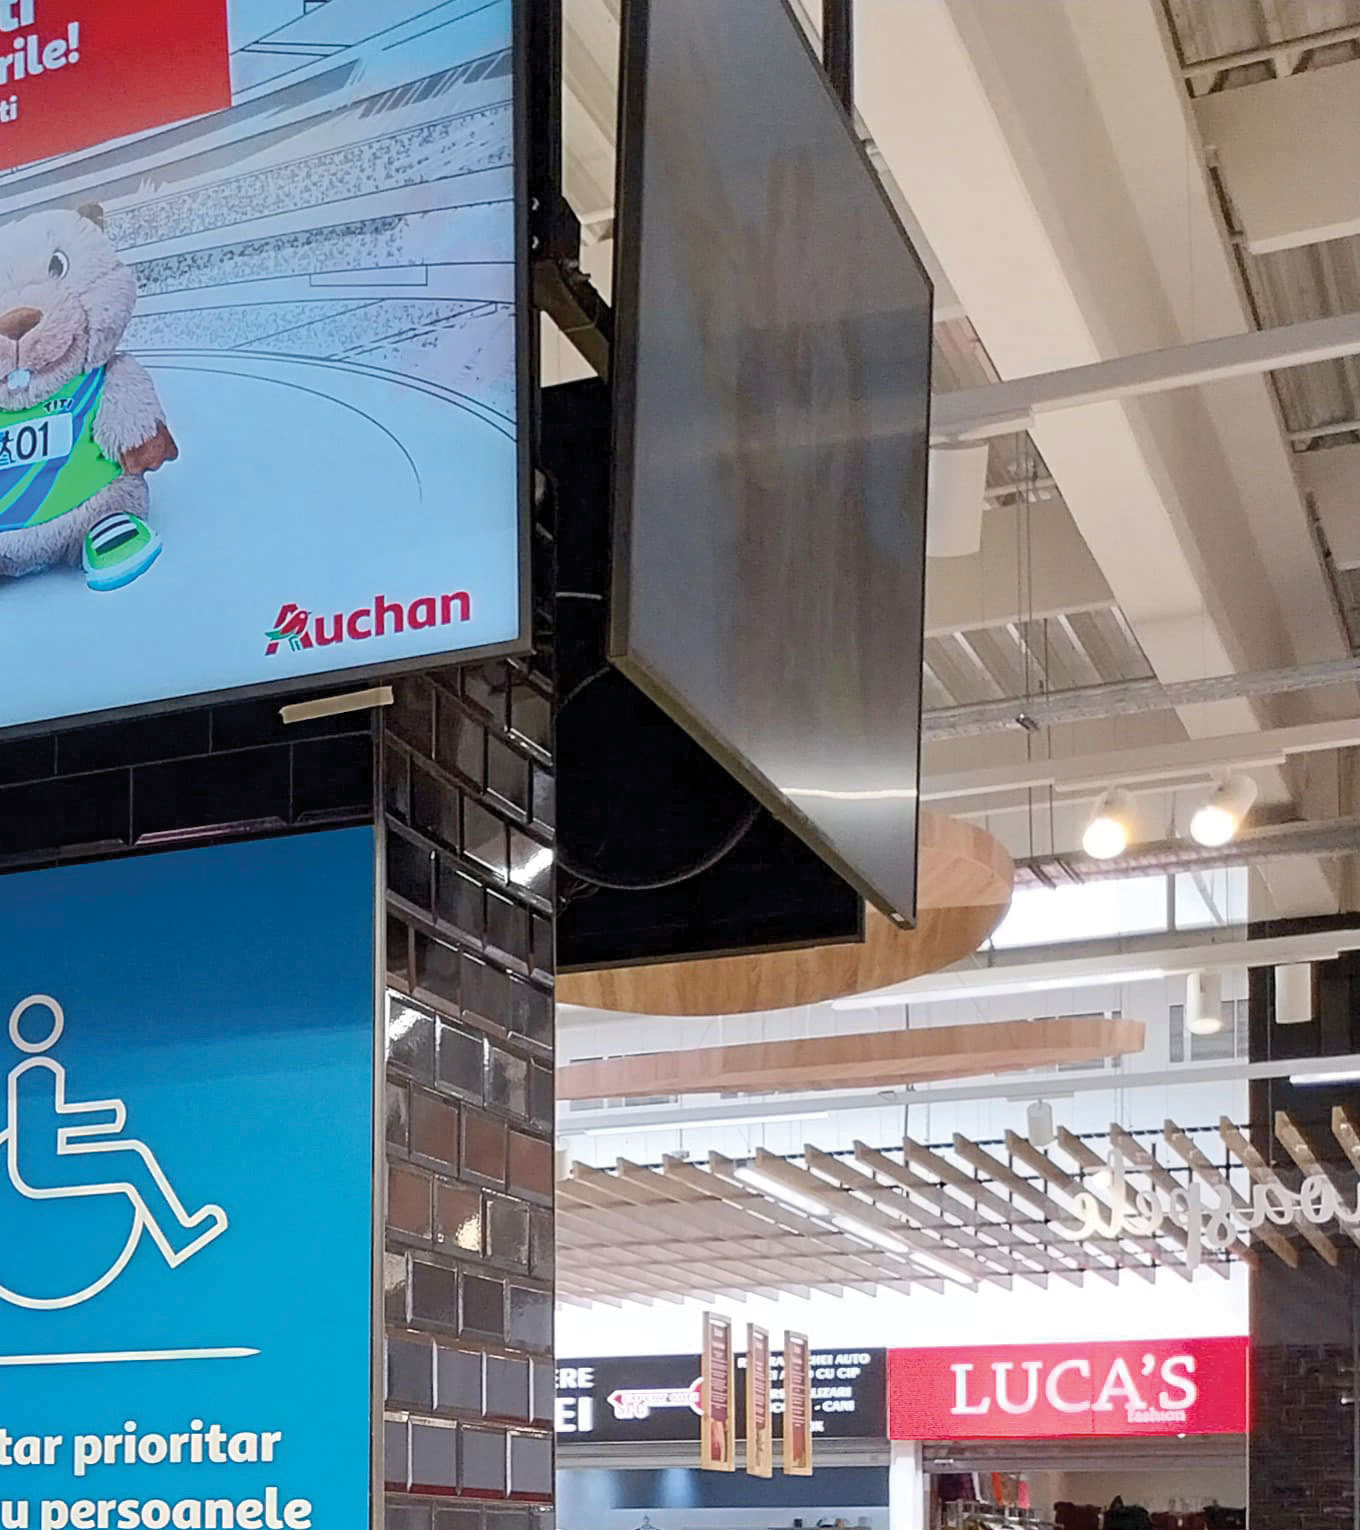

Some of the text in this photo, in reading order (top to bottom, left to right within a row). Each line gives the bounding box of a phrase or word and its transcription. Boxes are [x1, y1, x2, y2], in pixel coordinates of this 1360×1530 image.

[15, 420, 48, 460] 01
[264, 590, 470, 656] Auchan
[815, 1366, 862, 1380] CU CIP
[834, 1352, 871, 1366] AUTO
[950, 1353, 1198, 1415] LUCA'S
[73, 1419, 282, 1477] prioritar
